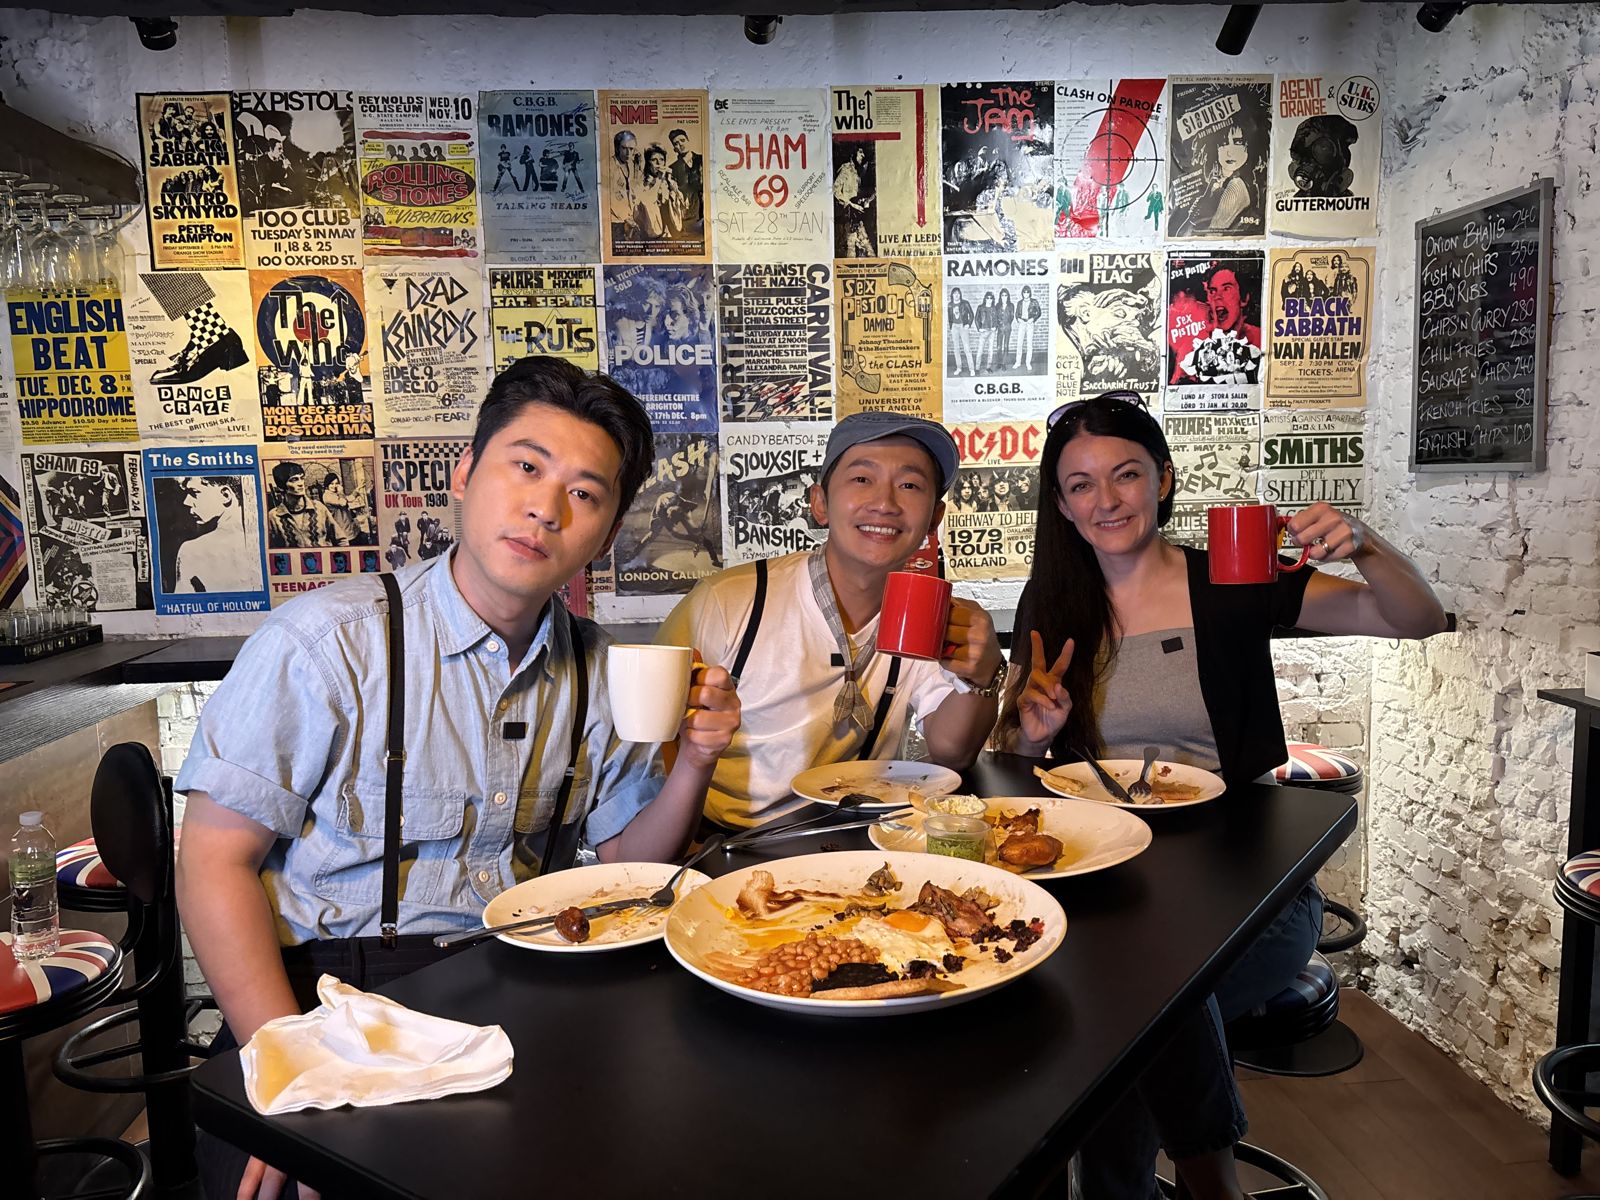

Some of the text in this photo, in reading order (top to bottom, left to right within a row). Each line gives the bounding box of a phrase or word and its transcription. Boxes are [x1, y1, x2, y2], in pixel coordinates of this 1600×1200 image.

[1280, 77, 1323, 100] AGENT
[359, 96, 423, 104] REYNOLDS
[1057, 86, 1162, 113] CLASH ON PAROLE
[1339, 93, 1376, 114] SUBS
[361, 105, 422, 113] COLISEUM
[454, 98, 472, 120] 10
[610, 105, 658, 124] NME
[1280, 98, 1327, 118] ORANGE
[488, 114, 588, 137] RAMONES
[162, 140, 222, 153] BLACK
[724, 133, 807, 171] SHAM
[150, 152, 229, 167] SABBATH
[367, 161, 467, 194] ROLLING
[383, 184, 468, 205] STONES
[753, 174, 789, 208] 69
[161, 192, 228, 206] LYNYRD
[496, 202, 588, 210] TALKING HEADS
[1276, 197, 1370, 211] GUTTERMOUTH
[153, 205, 237, 220] SKYNYRD
[258, 210, 350, 227] 100 CLUB
[1239, 216, 1260, 225] 1984
[178, 224, 214, 234] PETER
[251, 227, 356, 241] TUESDAY'S IN MAY
[162, 233, 233, 243] FRAMPTON
[1426, 236, 1459, 257] ONION
[258, 256, 357, 266] 100 OXFORD ST.
[947, 258, 1049, 277] RAMONES
[1092, 254, 1150, 271] BLACK
[616, 265, 645, 281] TICKETS
[743, 264, 807, 276] AGAINST
[1422, 258, 1448, 286] FISH
[1464, 252, 1499, 278] CHIPS
[492, 270, 593, 289] FRIARS MAXWELL
[553, 280, 582, 288] HALL
[743, 277, 807, 287] THE NAZIS
[1092, 270, 1134, 284] FLAG
[405, 276, 469, 312] DEAD
[614, 280, 633, 293] SOLD
[744, 297, 807, 306] STEEL PULSE
[1422, 283, 1456, 316] BBQ
[1458, 280, 1488, 303] RIBS
[744, 306, 807, 316] BUZZCOCKS
[1285, 297, 1350, 318] BLACK
[1471, 306, 1511, 330] CURRY
[1511, 298, 1535, 322] 280
[7, 299, 125, 335] ENGLISH
[744, 317, 771, 325] CHINA
[1274, 317, 1361, 338] SABBATH
[381, 308, 478, 363] KENNEDYS
[496, 318, 595, 353] THE RUTS
[31, 336, 108, 370] BEAT
[615, 344, 713, 366] POLICE
[745, 349, 807, 357] MANCHESTER
[1273, 342, 1361, 359] VAN HALEN
[1455, 340, 1497, 358] FRIES
[869, 360, 922, 369] the CLASH
[1057, 372, 1075, 380] THE
[1419, 355, 1534, 395] SAUSAGE CHIPS 240
[16, 375, 118, 397] TUE. DEC. 8
[1056, 381, 1077, 389] BLUE
[158, 386, 231, 401] DANCE
[673, 394, 700, 402] CENTRE
[1056, 389, 1076, 397] NOTE
[17, 396, 136, 419] HIPPODROME
[163, 400, 229, 415] CRAZE
[1418, 388, 1532, 422] FRENCH FRIES 80
[265, 414, 372, 425] THE GARDEN
[655, 412, 707, 420] 17th DEC. 8pm
[265, 424, 373, 436] BOSTON MA
[1165, 417, 1258, 435] FRIARS MAXWELL
[1418, 427, 1466, 455] ENGLISH
[1470, 424, 1510, 446] CHIPS
[381, 444, 410, 459] THE
[36, 455, 99, 475] SHAM 69
[148, 452, 254, 467] The Smiths
[1263, 478, 1362, 501] SHELLEY
[948, 513, 1012, 528] HIGHWAY TO
[948, 529, 1003, 544] 1979
[948, 543, 1004, 556] TOUR
[950, 556, 1007, 568] OAKLAND
